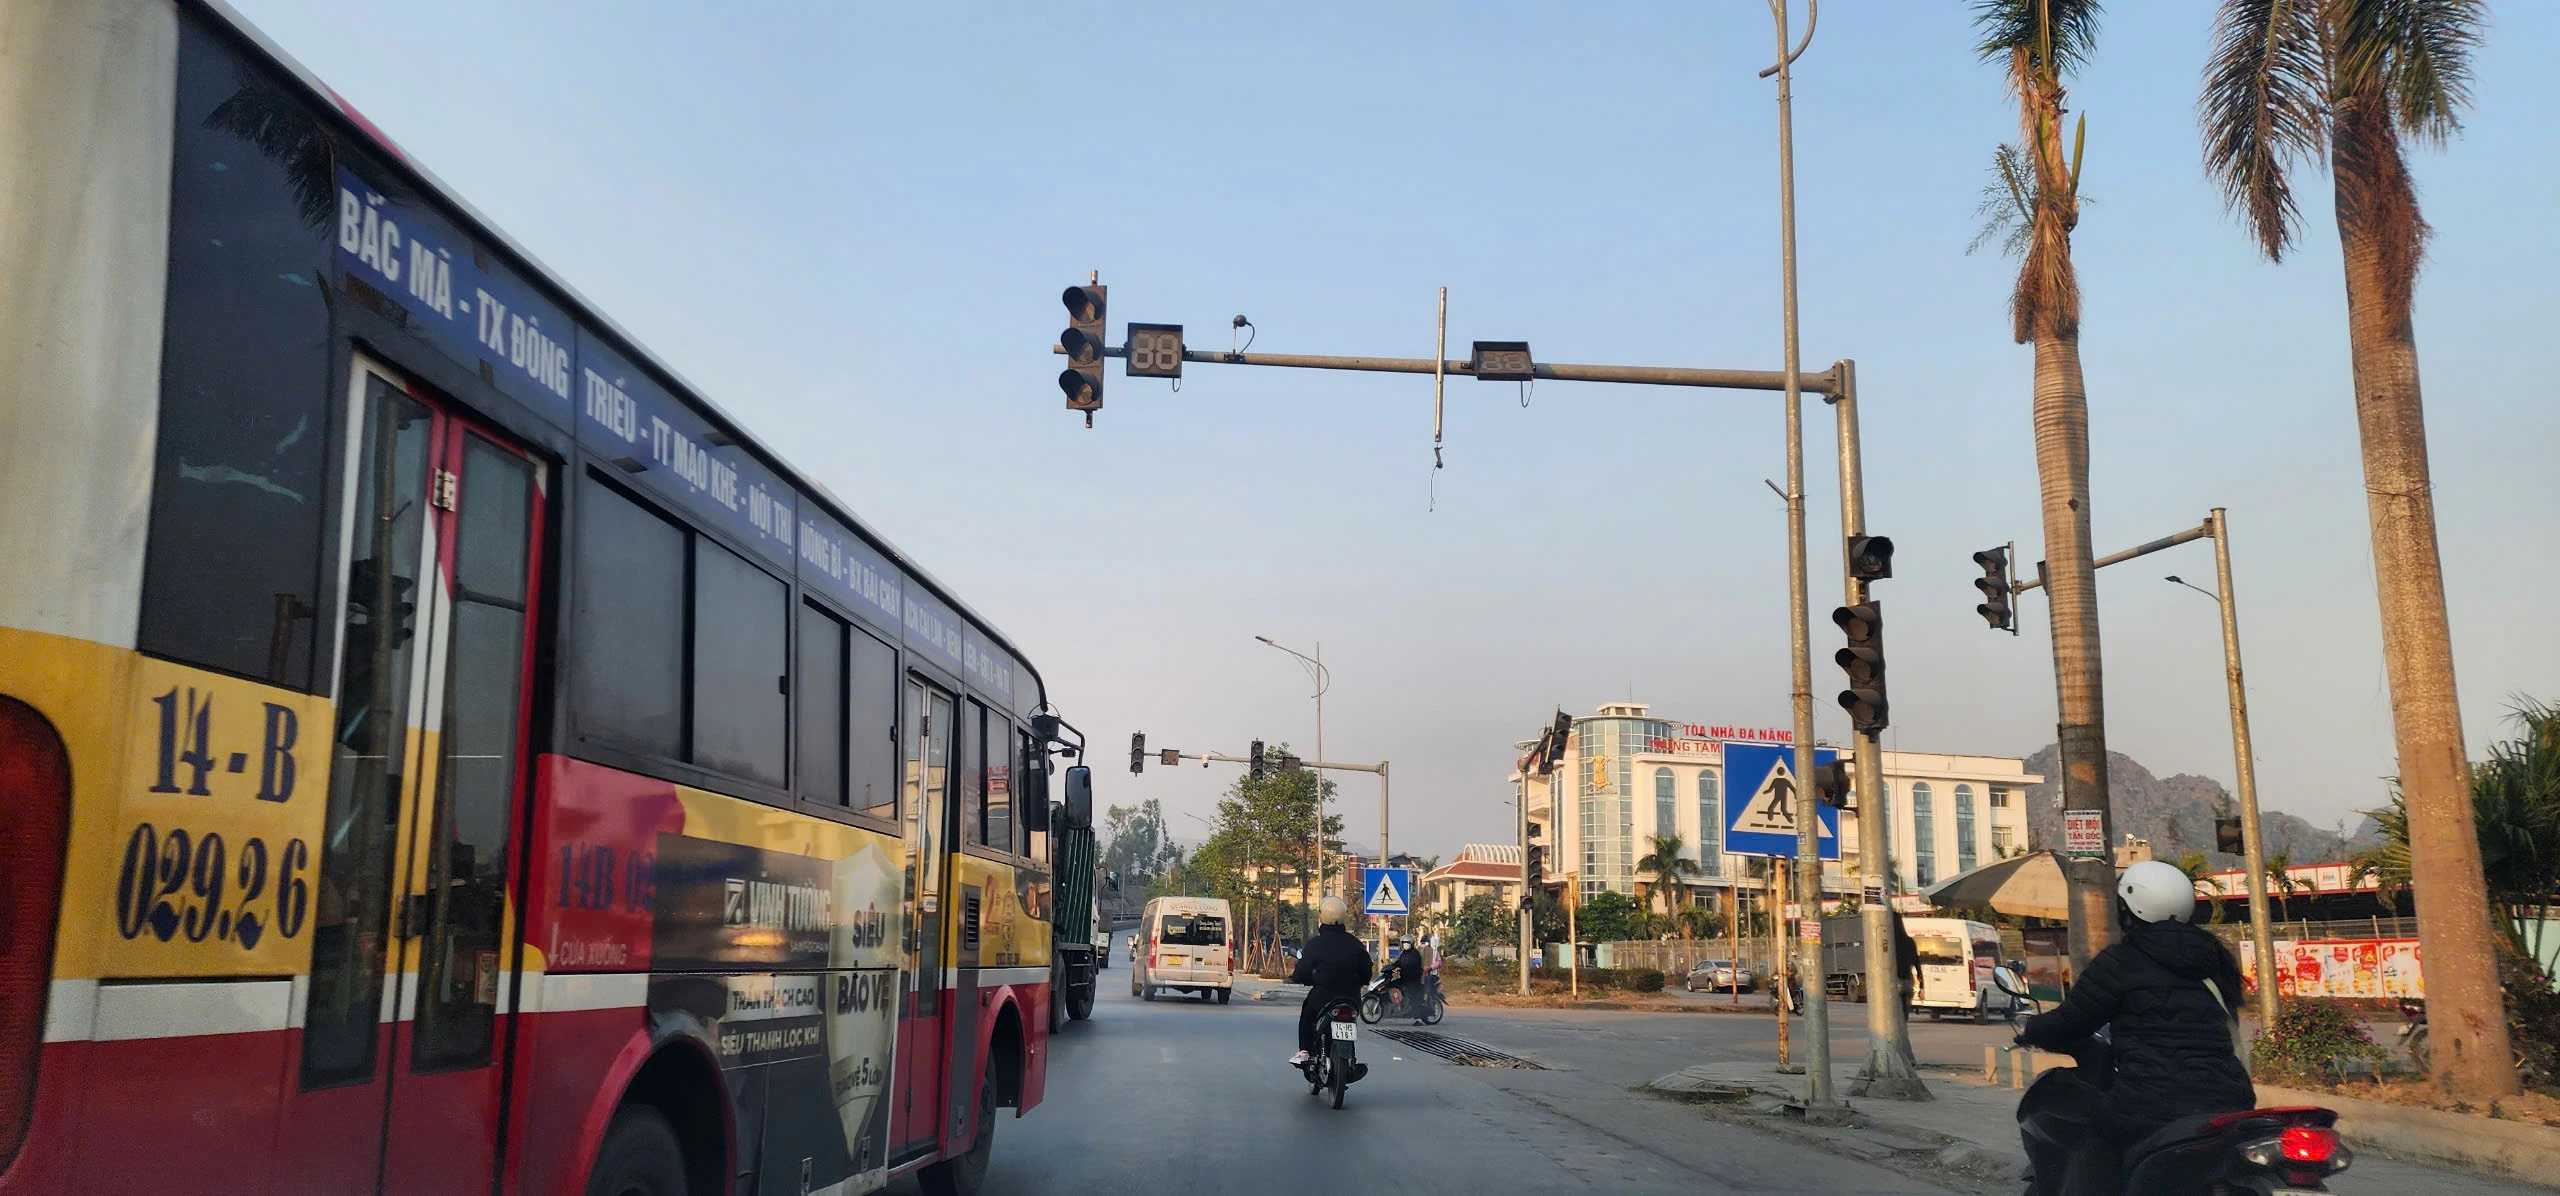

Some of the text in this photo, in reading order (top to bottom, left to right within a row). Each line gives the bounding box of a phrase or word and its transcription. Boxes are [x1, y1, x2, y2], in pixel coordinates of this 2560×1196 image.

[339, 186, 400, 282] BẮC
[475, 287, 506, 357] TX
[511, 314, 568, 400] ĐÔNG
[652, 415, 671, 467] TT
[673, 431, 708, 493] MẠO
[711, 456, 738, 512] KHÊ
[749, 482, 771, 539] NỘI
[1710, 724, 1735, 738] NHÀ
[1759, 729, 1793, 742] NĂNG
[853, 902, 885, 949] SIÊU
[795, 987, 815, 1006] CAO
[837, 960, 869, 1015] BẢO
[721, 1020, 821, 1056] SIÊU THANH LỌC KHÍ
[861, 1057, 869, 1086] 5
